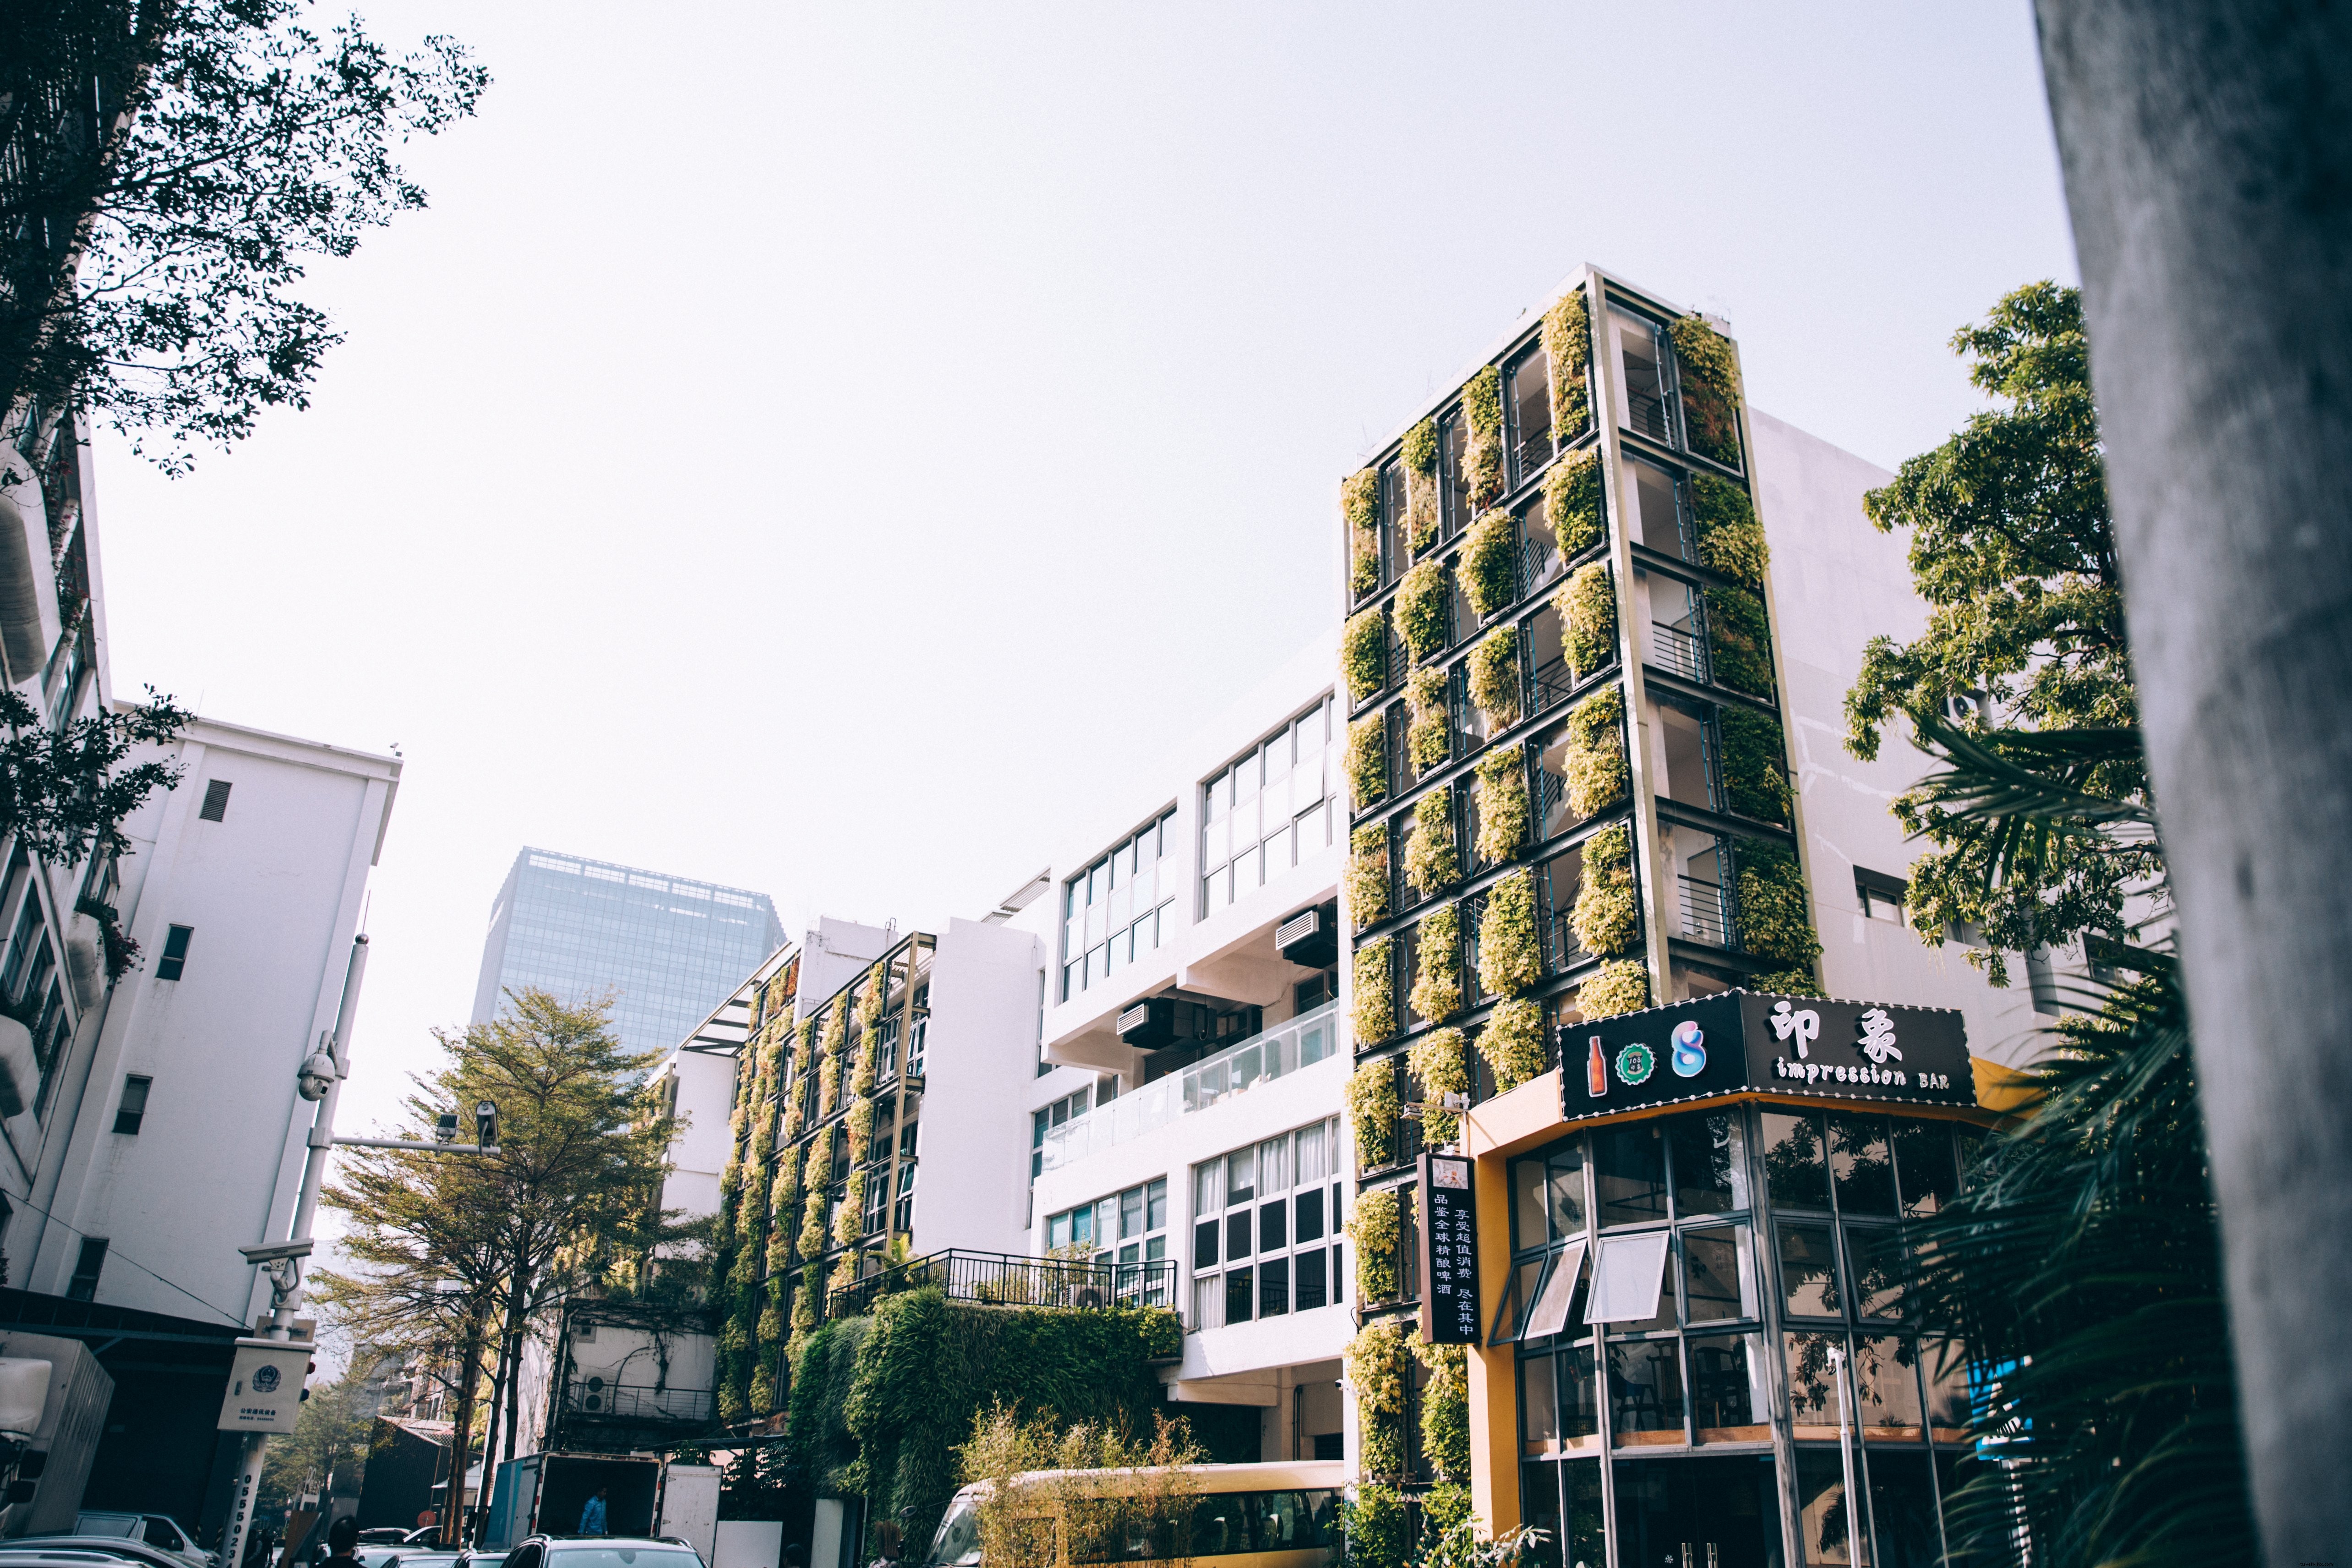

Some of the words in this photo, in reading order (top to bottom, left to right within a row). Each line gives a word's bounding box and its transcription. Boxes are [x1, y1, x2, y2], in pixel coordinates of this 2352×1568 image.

[1770, 1001, 1902, 1063] 印象
[1777, 1056, 1906, 1086] impression
[1918, 1072, 1949, 1090] BAR
[1434, 1194, 1452, 1295] 品鉴全球精酿啤酒
[1455, 1209, 1472, 1279] 享受超值消费
[1457, 1289, 1474, 1335] 尽在其中
